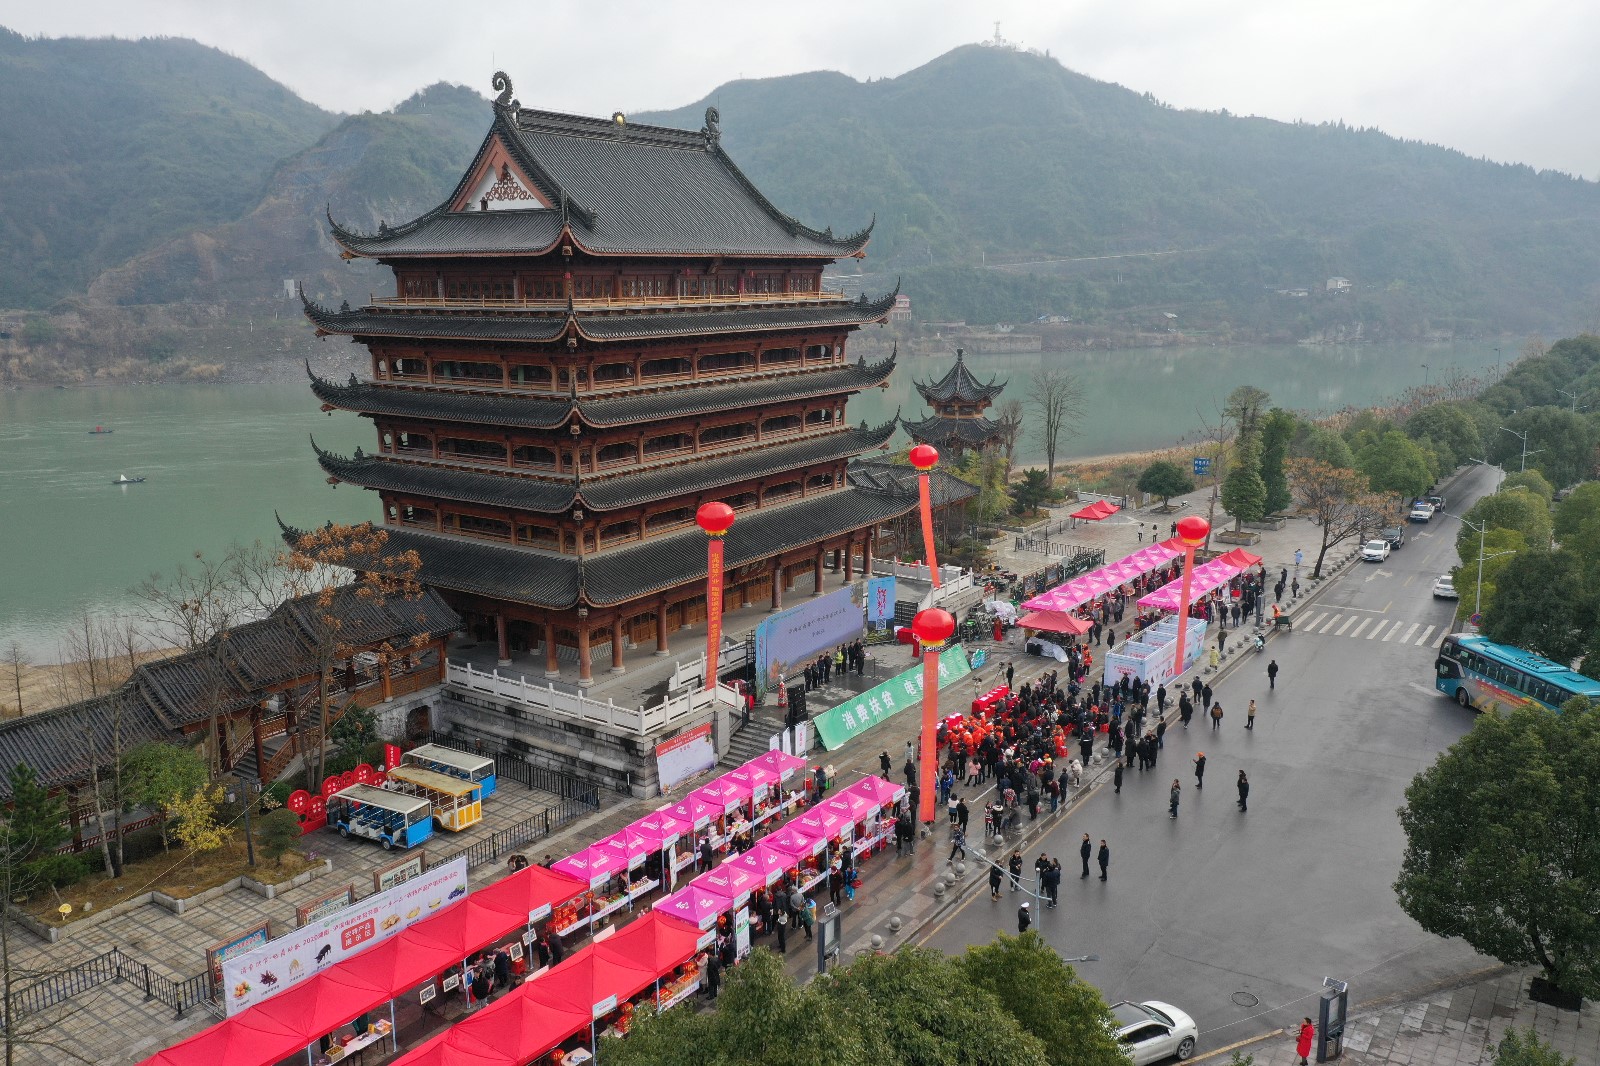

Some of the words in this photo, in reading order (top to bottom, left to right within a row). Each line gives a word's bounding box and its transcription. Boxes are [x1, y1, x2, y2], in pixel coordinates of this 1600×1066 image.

[841, 690, 895, 731] 消费扶贫
[345, 922, 371, 938] 农特产品
[345, 930, 371, 946] 展示区
